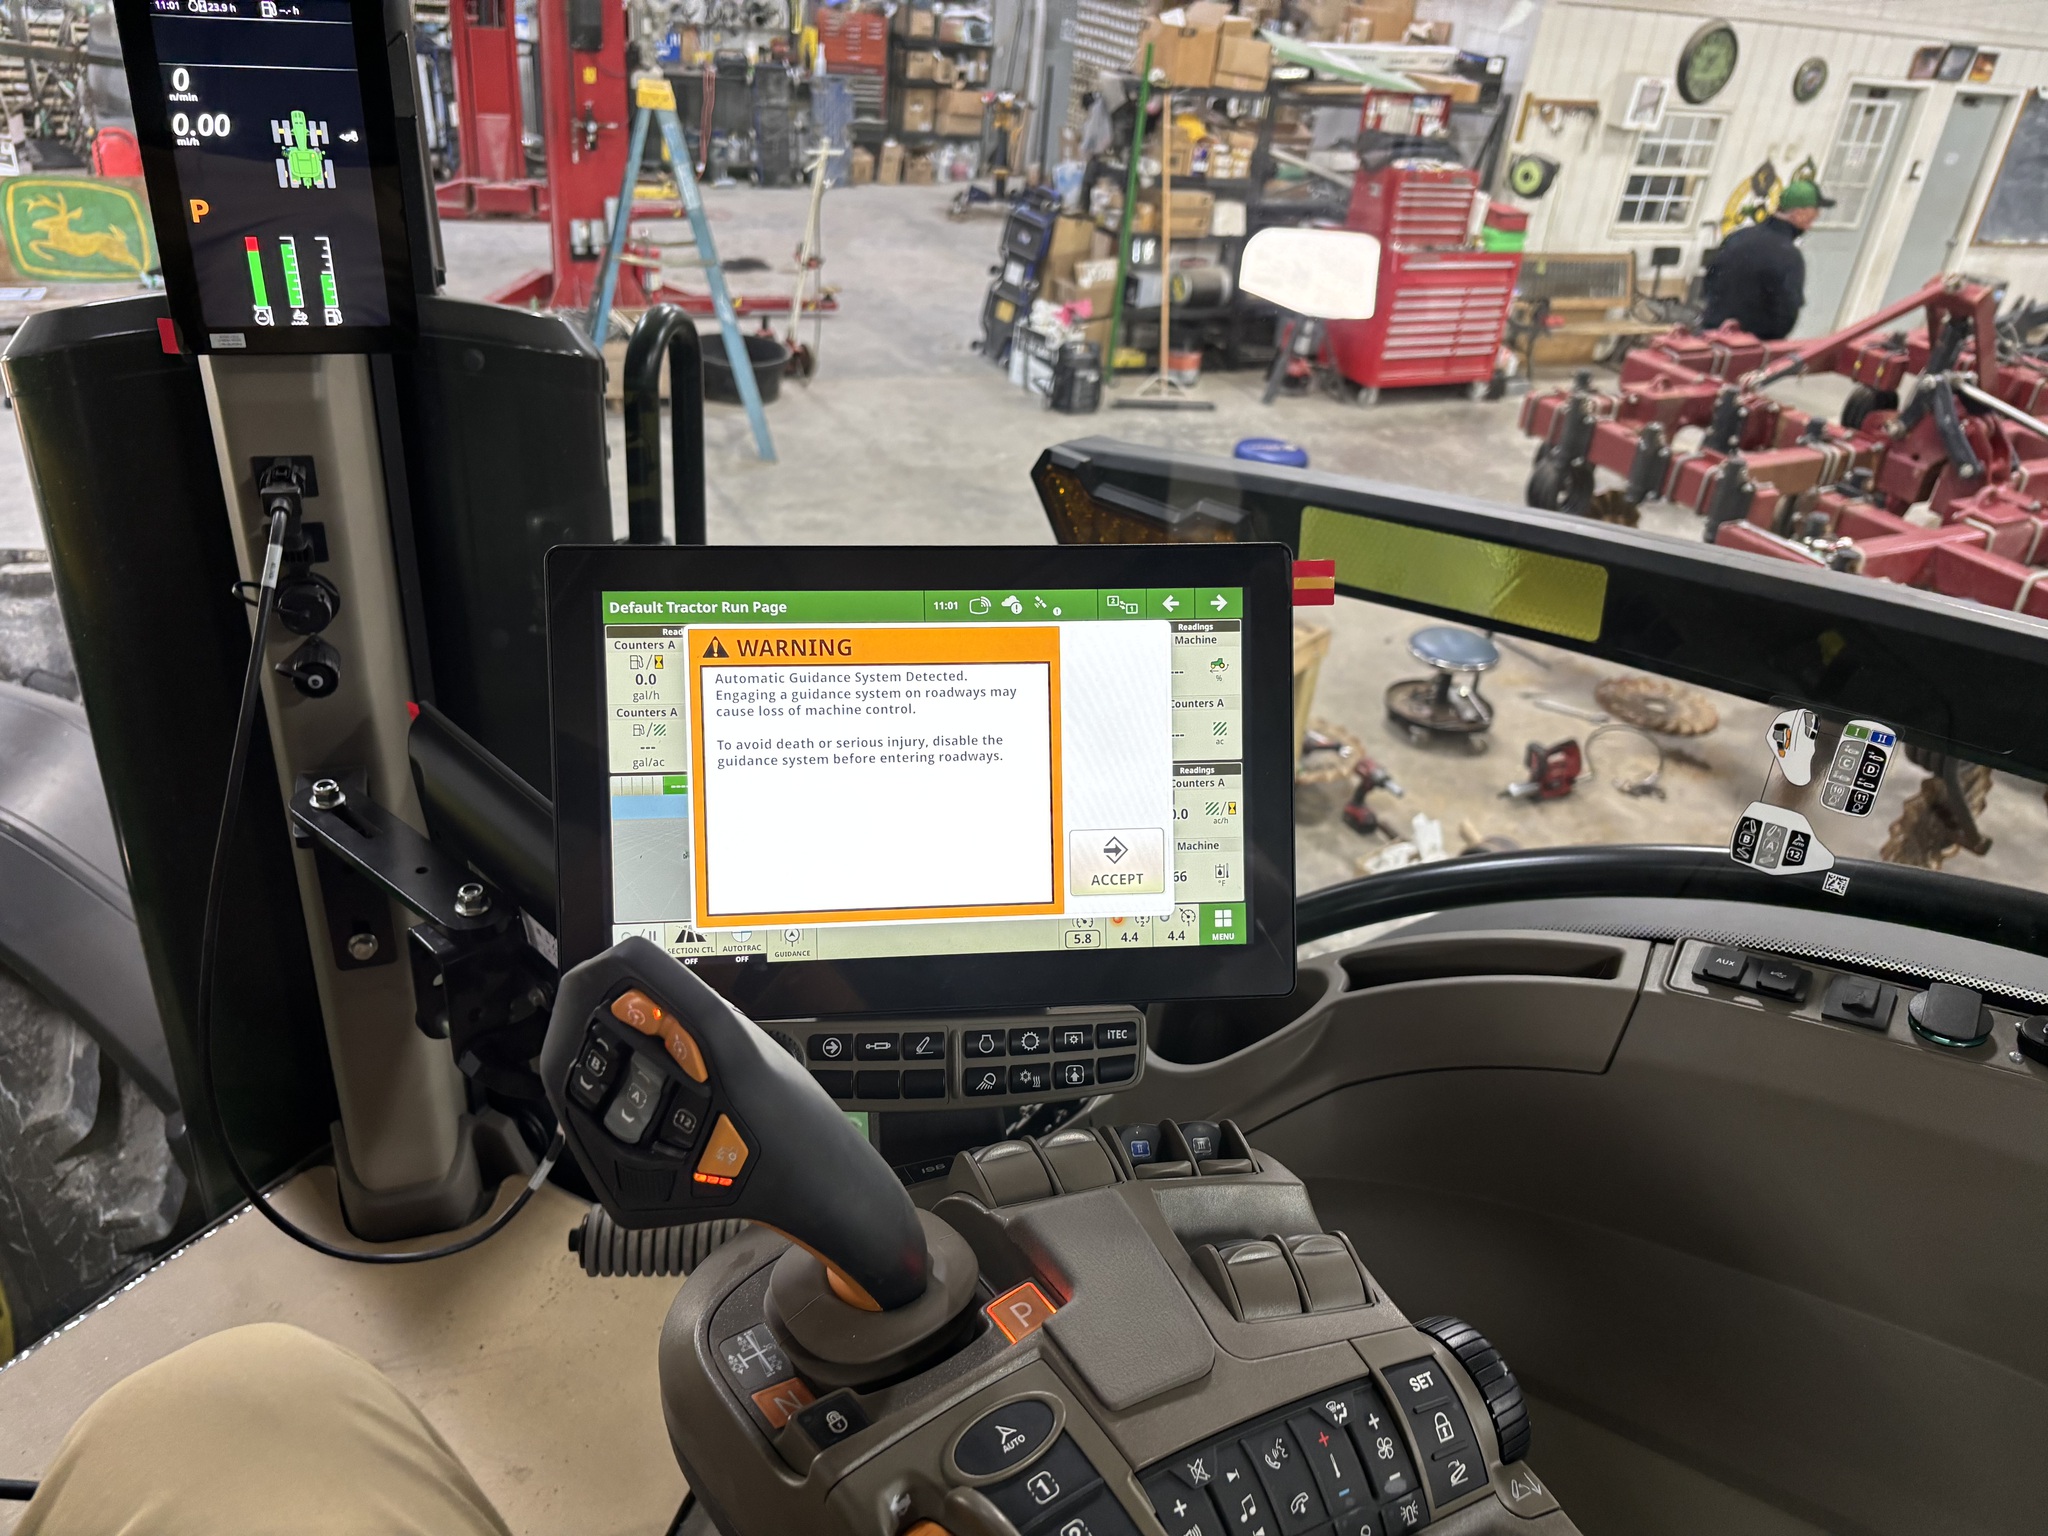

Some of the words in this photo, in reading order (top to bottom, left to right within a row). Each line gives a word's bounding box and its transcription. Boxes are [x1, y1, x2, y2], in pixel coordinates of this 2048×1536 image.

[154, 0, 180, 10] 11:01
[208, 2, 228, 12] 23.9
[230, 3, 237, 12] h
[293, 6, 300, 15] h
[172, 68, 190, 91] 0
[169, 93, 199, 102] n/min
[173, 113, 231, 137] 0.00
[177, 137, 200, 146] mi/h
[190, 199, 210, 223] P
[609, 601, 663, 614] Default
[666, 602, 718, 614] Tractor
[721, 602, 749, 613] Run
[753, 601, 787, 616] Page
[933, 601, 958, 611] 11:01
[662, 628, 684, 637] Read
[1178, 623, 1214, 633] Readings
[614, 641, 664, 650] Counters
[668, 641, 676, 650] A
[1175, 636, 1218, 645] Machine
[736, 638, 852, 657] WARNING
[635, 674, 657, 686] 0.0
[715, 673, 785, 684] Automatic
[789, 672, 851, 684] Guidance
[855, 672, 902, 686] System
[906, 671, 968, 682] Detected.
[632, 690, 660, 703] gal/h
[716, 690, 776, 704] Engaging
[780, 692, 788, 700] a
[792, 689, 851, 704] guidance
[855, 689, 901, 702] system
[905, 690, 921, 699] on
[925, 688, 987, 701] roadways
[990, 688, 1017, 700] may
[1217, 699, 1225, 708] A
[616, 708, 667, 718] Counters
[670, 708, 678, 717] A
[716, 708, 755, 717] cause
[759, 707, 784, 717] loss
[788, 706, 802, 716] of
[805, 705, 861, 717] machine
[866, 704, 917, 715] control.
[717, 740, 732, 751] To
[736, 739, 773, 750] avoid
[776, 738, 815, 750] death
[818, 740, 832, 749] or
[836, 738, 884, 749] serious
[888, 736, 929, 750] injury,
[933, 736, 978, 747] disable
[983, 735, 1004, 746] the
[1878, 735, 1888, 744] II
[632, 758, 665, 769] gal/ac
[717, 756, 778, 769] guidance
[782, 757, 829, 768] system
[833, 753, 876, 765] before
[880, 752, 935, 765] entering
[939, 751, 1003, 764] roadways.
[1843, 759, 1851, 768] C
[1180, 767, 1215, 776] Readings
[1867, 766, 1876, 774] D
[1218, 779, 1225, 787] A
[1857, 794, 1866, 802] 11
[1213, 817, 1229, 825] ac/h
[1743, 835, 1751, 844] B
[1178, 842, 1220, 851] Machine
[1767, 842, 1774, 851] A
[1790, 851, 1801, 859] 12
[1091, 874, 1144, 886] ACCEPT
[1074, 934, 1092, 944] 5.8
[1121, 932, 1139, 942] 4.4
[1168, 931, 1186, 941] 4.4
[1212, 933, 1235, 941] MENU
[668, 947, 700, 955] SECTION
[723, 945, 762, 953] AUTOTRAC
[775, 950, 811, 958] GUIDANCE
[1715, 957, 1735, 967] AUX
[1107, 1029, 1128, 1040] iTEC
[590, 1058, 602, 1071] B
[631, 1091, 640, 1103] A
[679, 1115, 693, 1128] 12
[1009, 1302, 1032, 1327] P
[1409, 1371, 1436, 1392] SET
[773, 1390, 804, 1417] N
[1003, 1434, 1026, 1453] AUTO
[1037, 1479, 1051, 1495] 1
